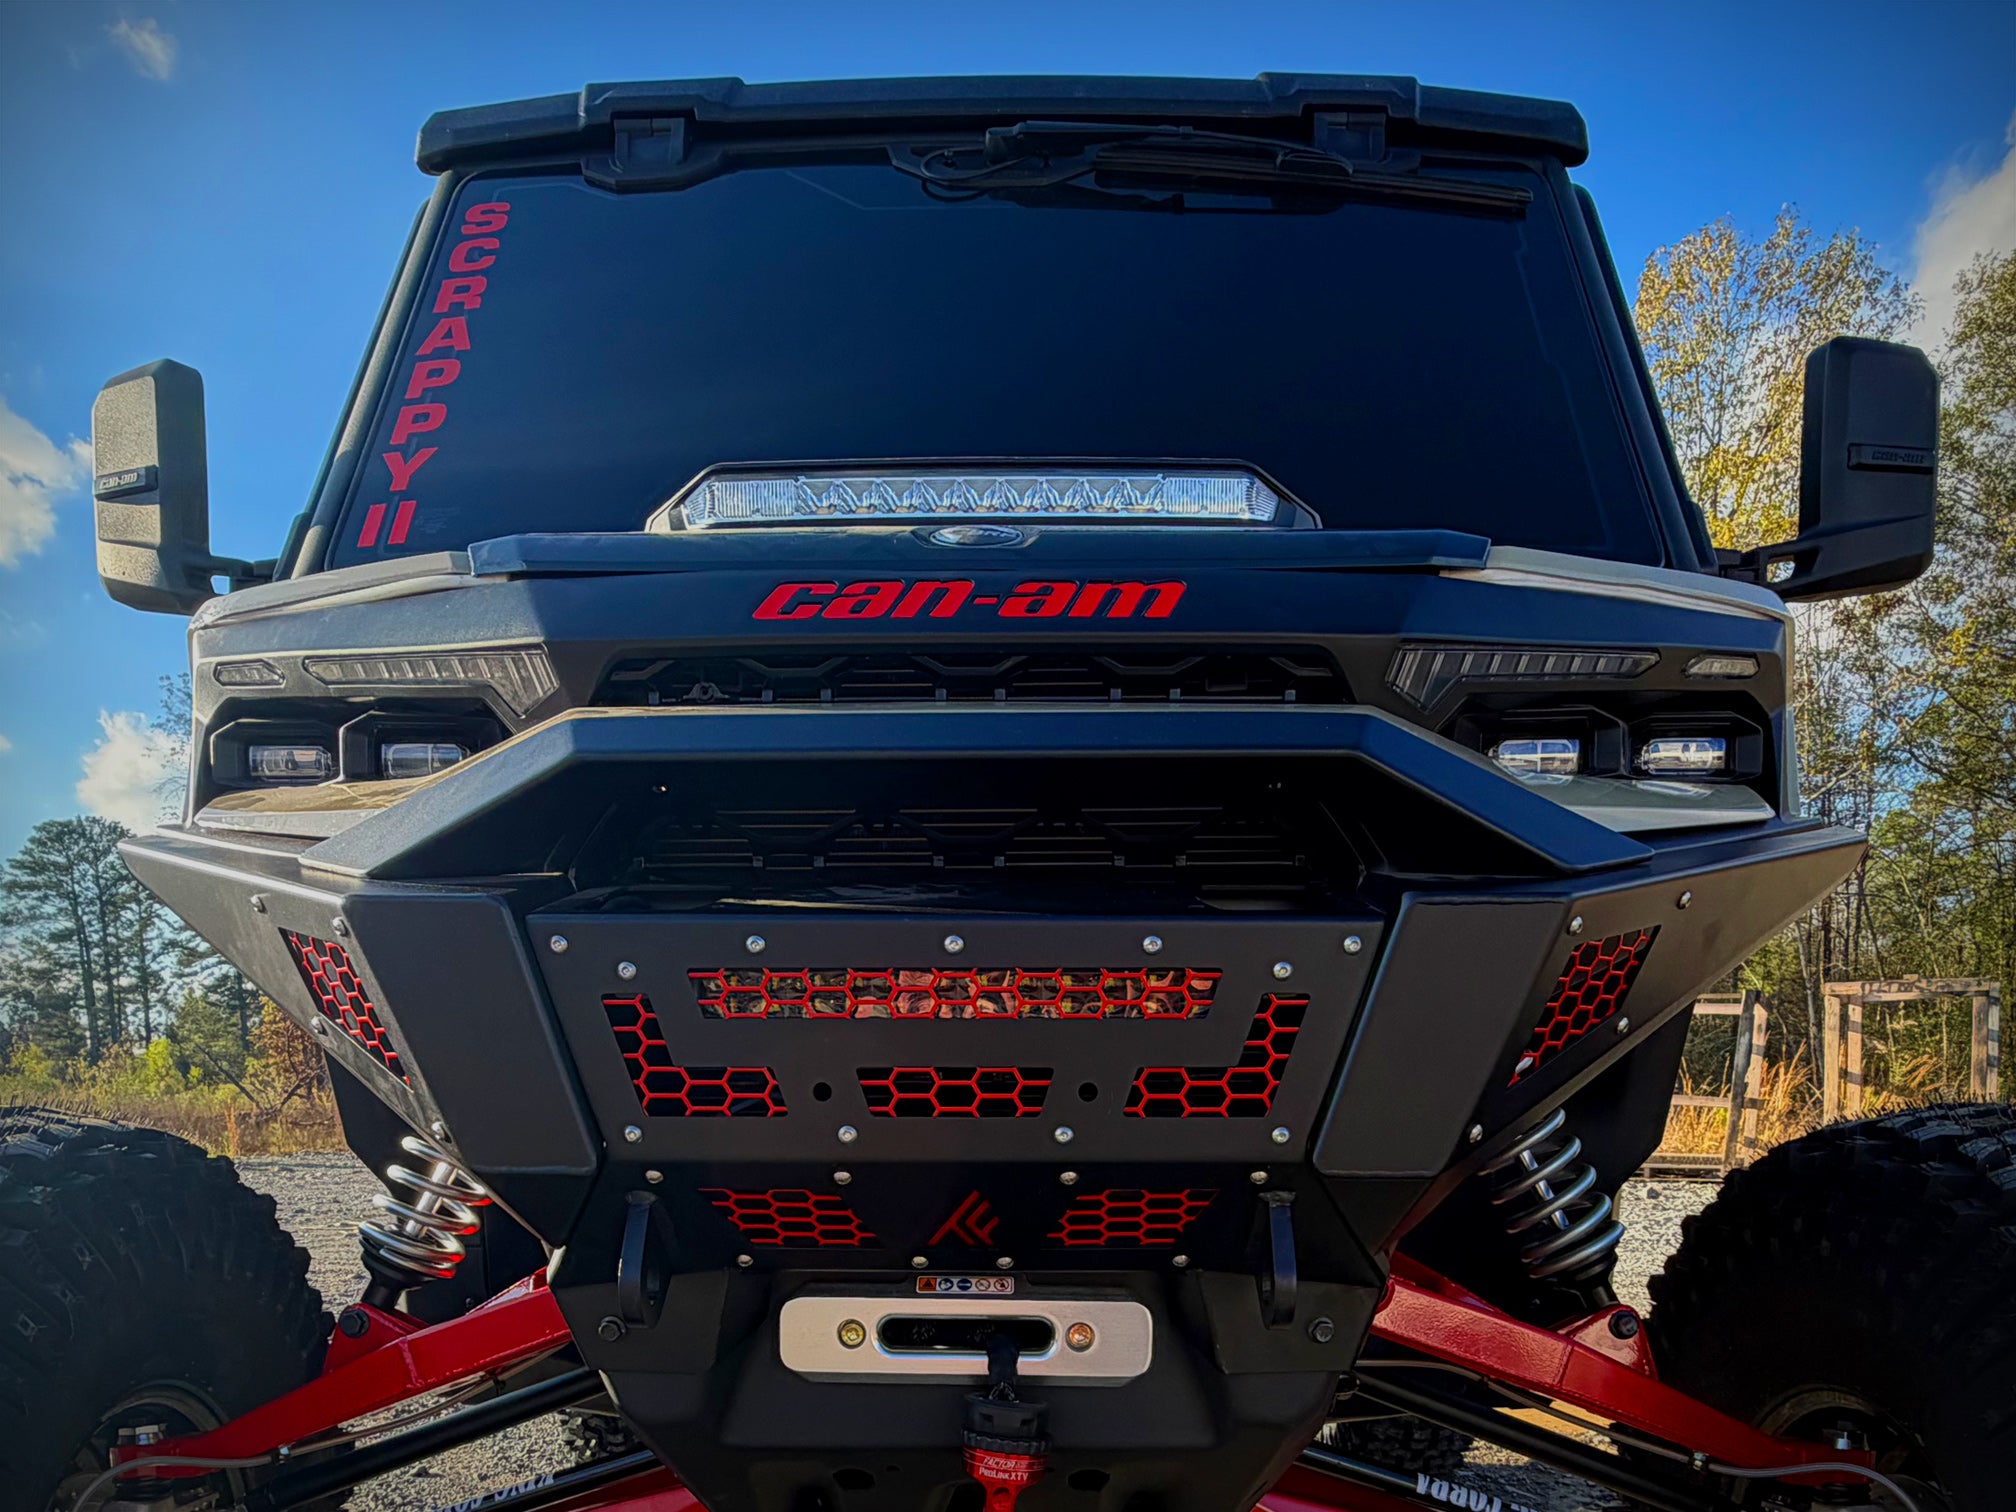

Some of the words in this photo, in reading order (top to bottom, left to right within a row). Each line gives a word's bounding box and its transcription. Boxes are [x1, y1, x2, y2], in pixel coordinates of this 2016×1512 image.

[382, 201, 511, 492] SCRAPPY
[357, 500, 416, 548] II
[751, 578, 1188, 620] can-am
[982, 1456, 1016, 1469] FACTOR
